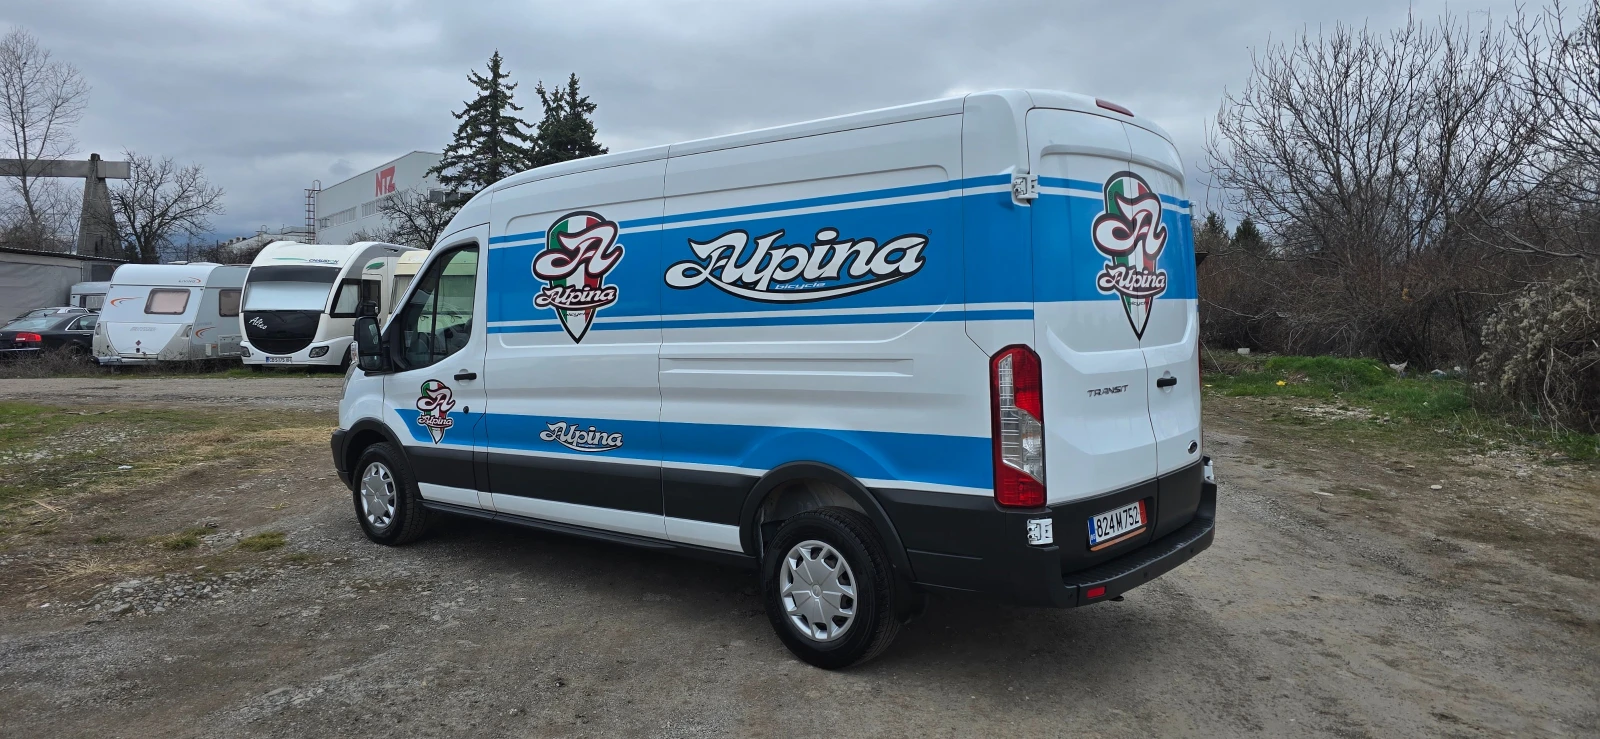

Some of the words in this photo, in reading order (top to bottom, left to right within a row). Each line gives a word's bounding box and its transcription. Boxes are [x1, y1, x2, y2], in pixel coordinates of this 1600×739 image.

[376, 166, 396, 198] NTZ
[665, 227, 929, 303] Alpina
[775, 281, 826, 291] bicycle
[1097, 265, 1167, 296] Alpina
[535, 286, 617, 309] Alpina
[1087, 384, 1129, 398] TRANSIT
[418, 415, 454, 429] Alpina
[540, 421, 624, 452] Alpina
